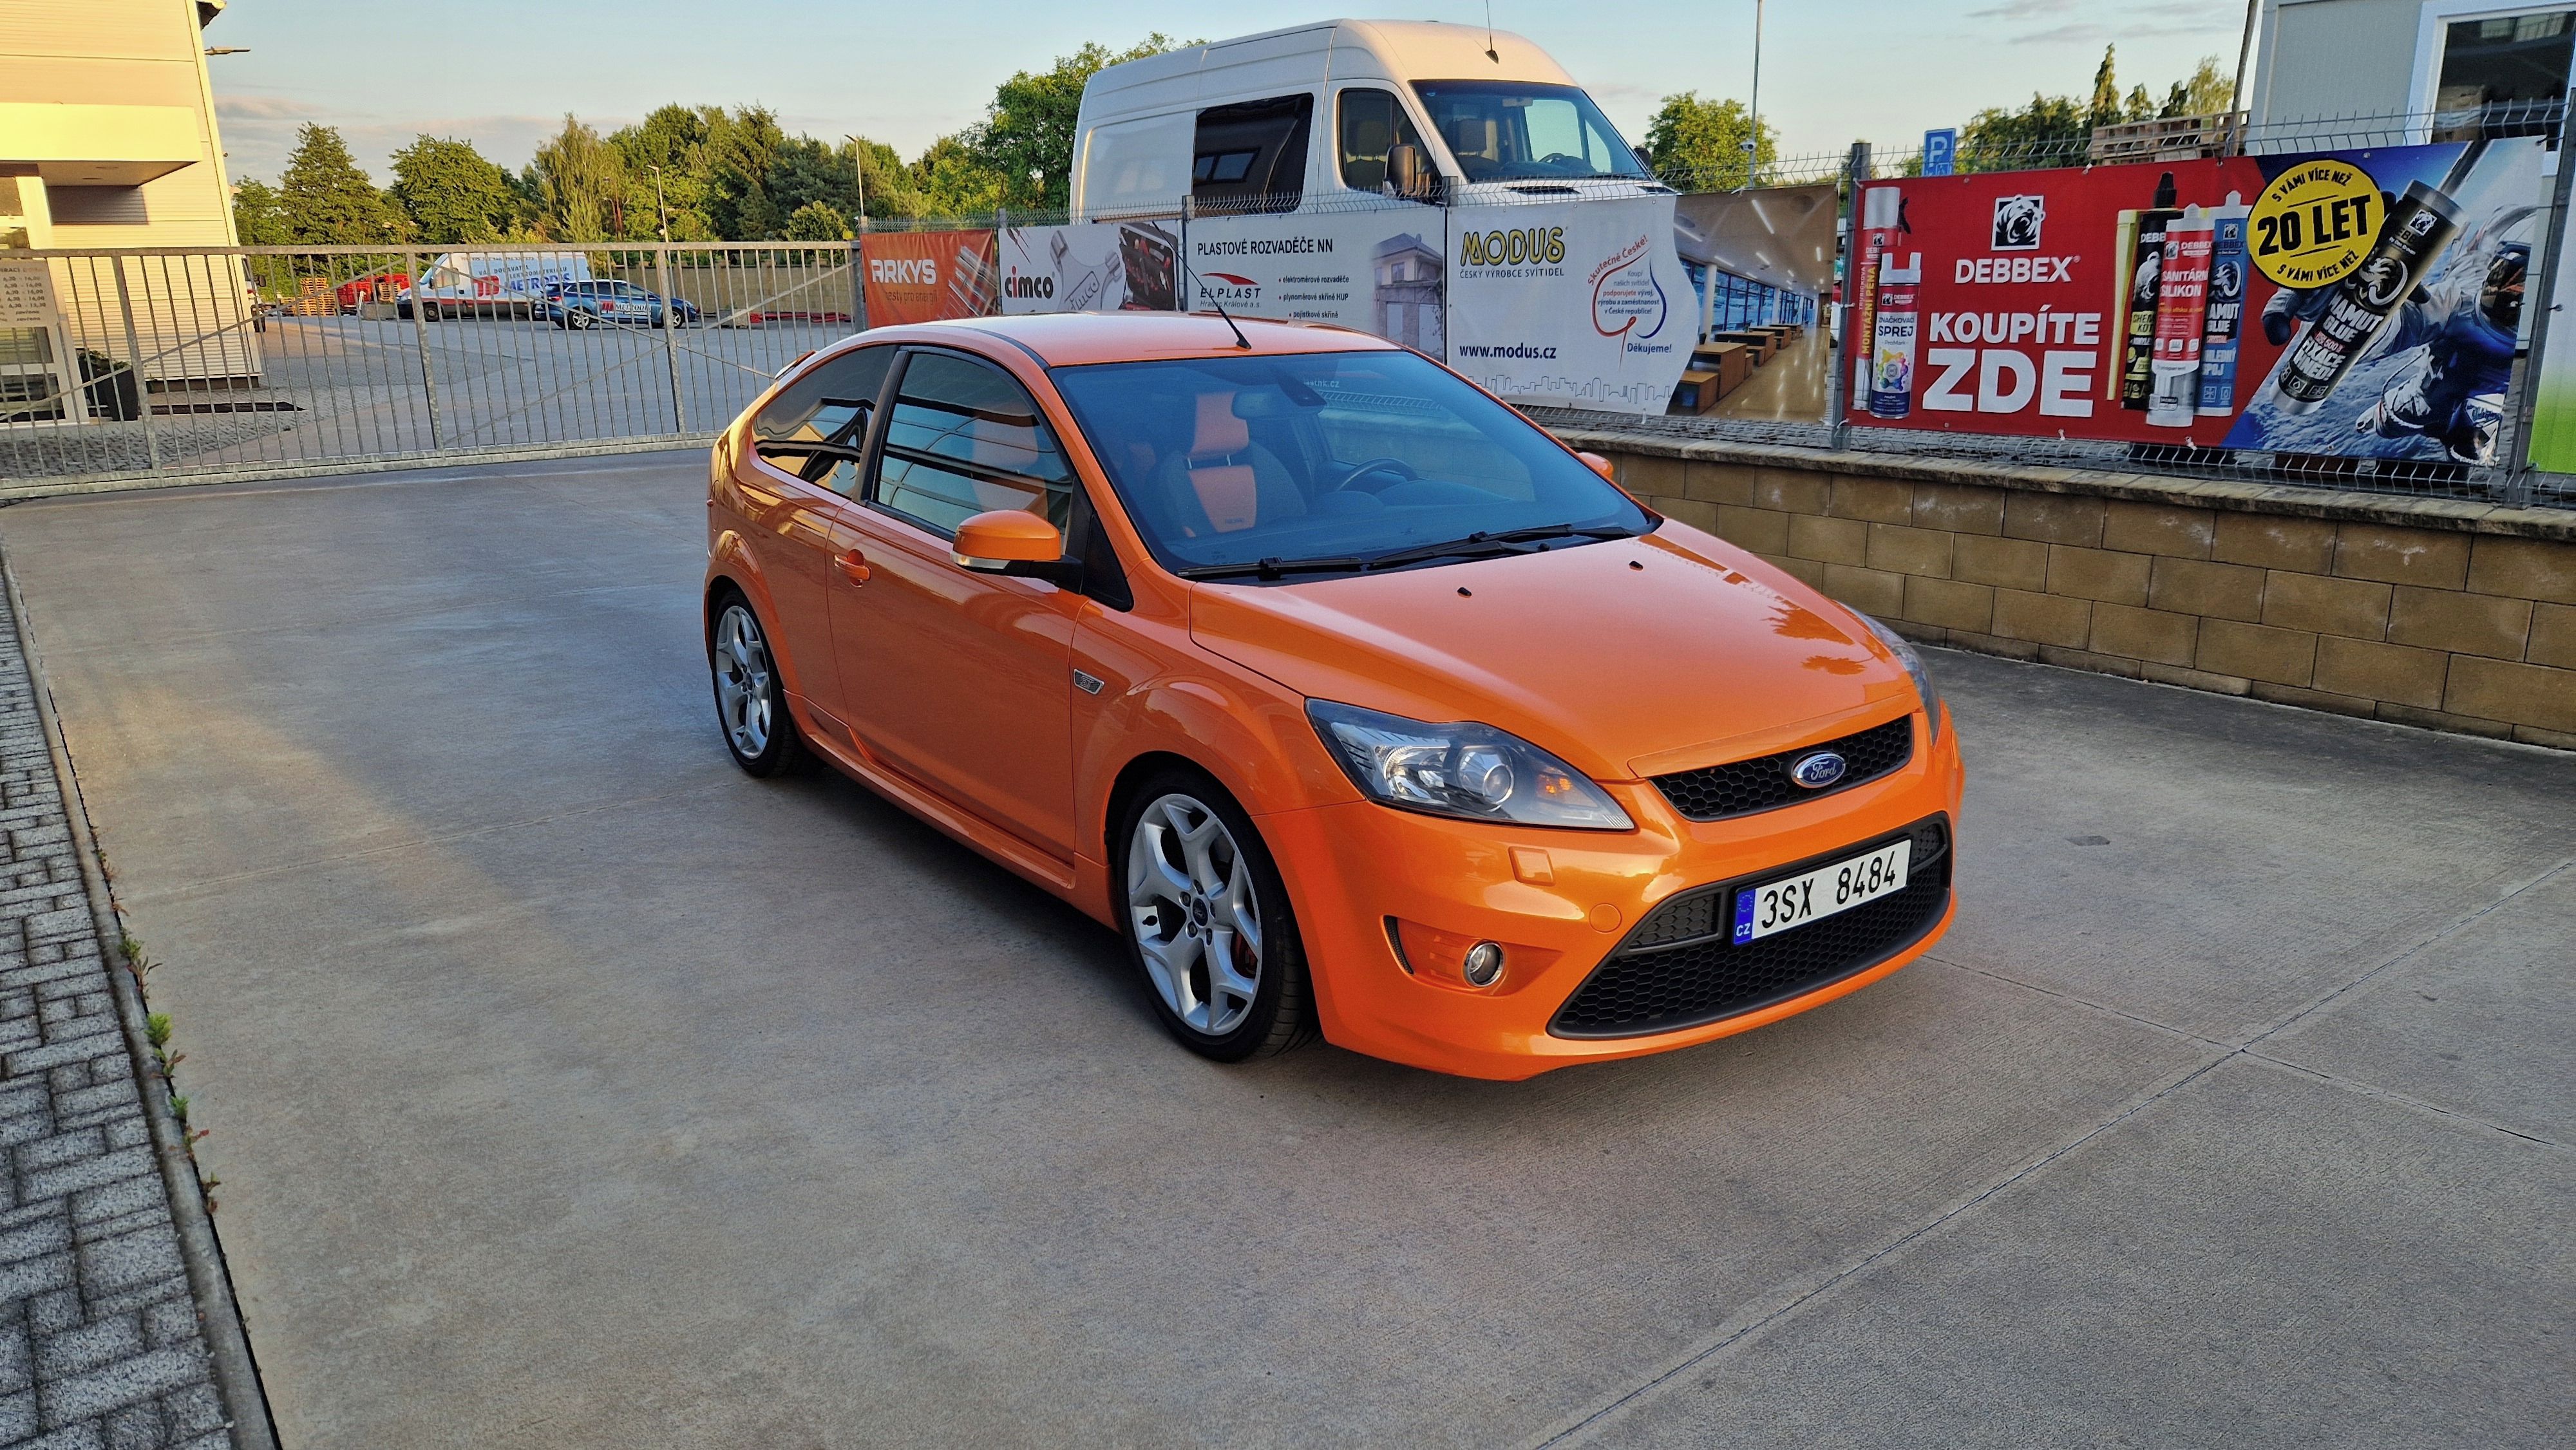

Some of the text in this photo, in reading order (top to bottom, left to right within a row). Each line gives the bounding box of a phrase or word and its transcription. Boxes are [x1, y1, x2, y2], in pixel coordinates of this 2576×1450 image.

[2272, 167, 2353, 202] S VÁMI VÍCE NEŽ
[2257, 194, 2371, 256] 20 LET
[1198, 237, 1333, 256] PLASTOVÉ ROZVADĚČE NN
[1460, 227, 1565, 267] MODUS
[871, 259, 936, 284] ARKYS
[1460, 267, 1564, 279] ČESKÝ VÝROBCE SVÍTIDEL
[1587, 234, 1649, 286] Skutečně České!
[1955, 256, 2073, 283] DEBBEX
[2277, 249, 2359, 281] S VÁMI VÍCE NEŽ
[1005, 265, 1054, 299] cimco
[1200, 288, 1261, 299] ELPLAST
[904, 292, 915, 304] pro
[2209, 303, 2240, 319] AMUT
[1293, 311, 1320, 319] pojistkové
[1929, 304, 2101, 344] KOUPÍTE
[2329, 291, 2385, 333] MAMUT
[1878, 326, 1913, 337] SPREJ
[2323, 315, 2358, 343] GLUE
[1459, 342, 1557, 359] www.modus.cz
[1627, 343, 1672, 355] Děkujeme!
[1922, 348, 2097, 418] ZDE
[1810, 760, 1837, 780] Ford
[1761, 851, 1895, 928] 3SX 8484
[1736, 923, 1750, 937] CZ
